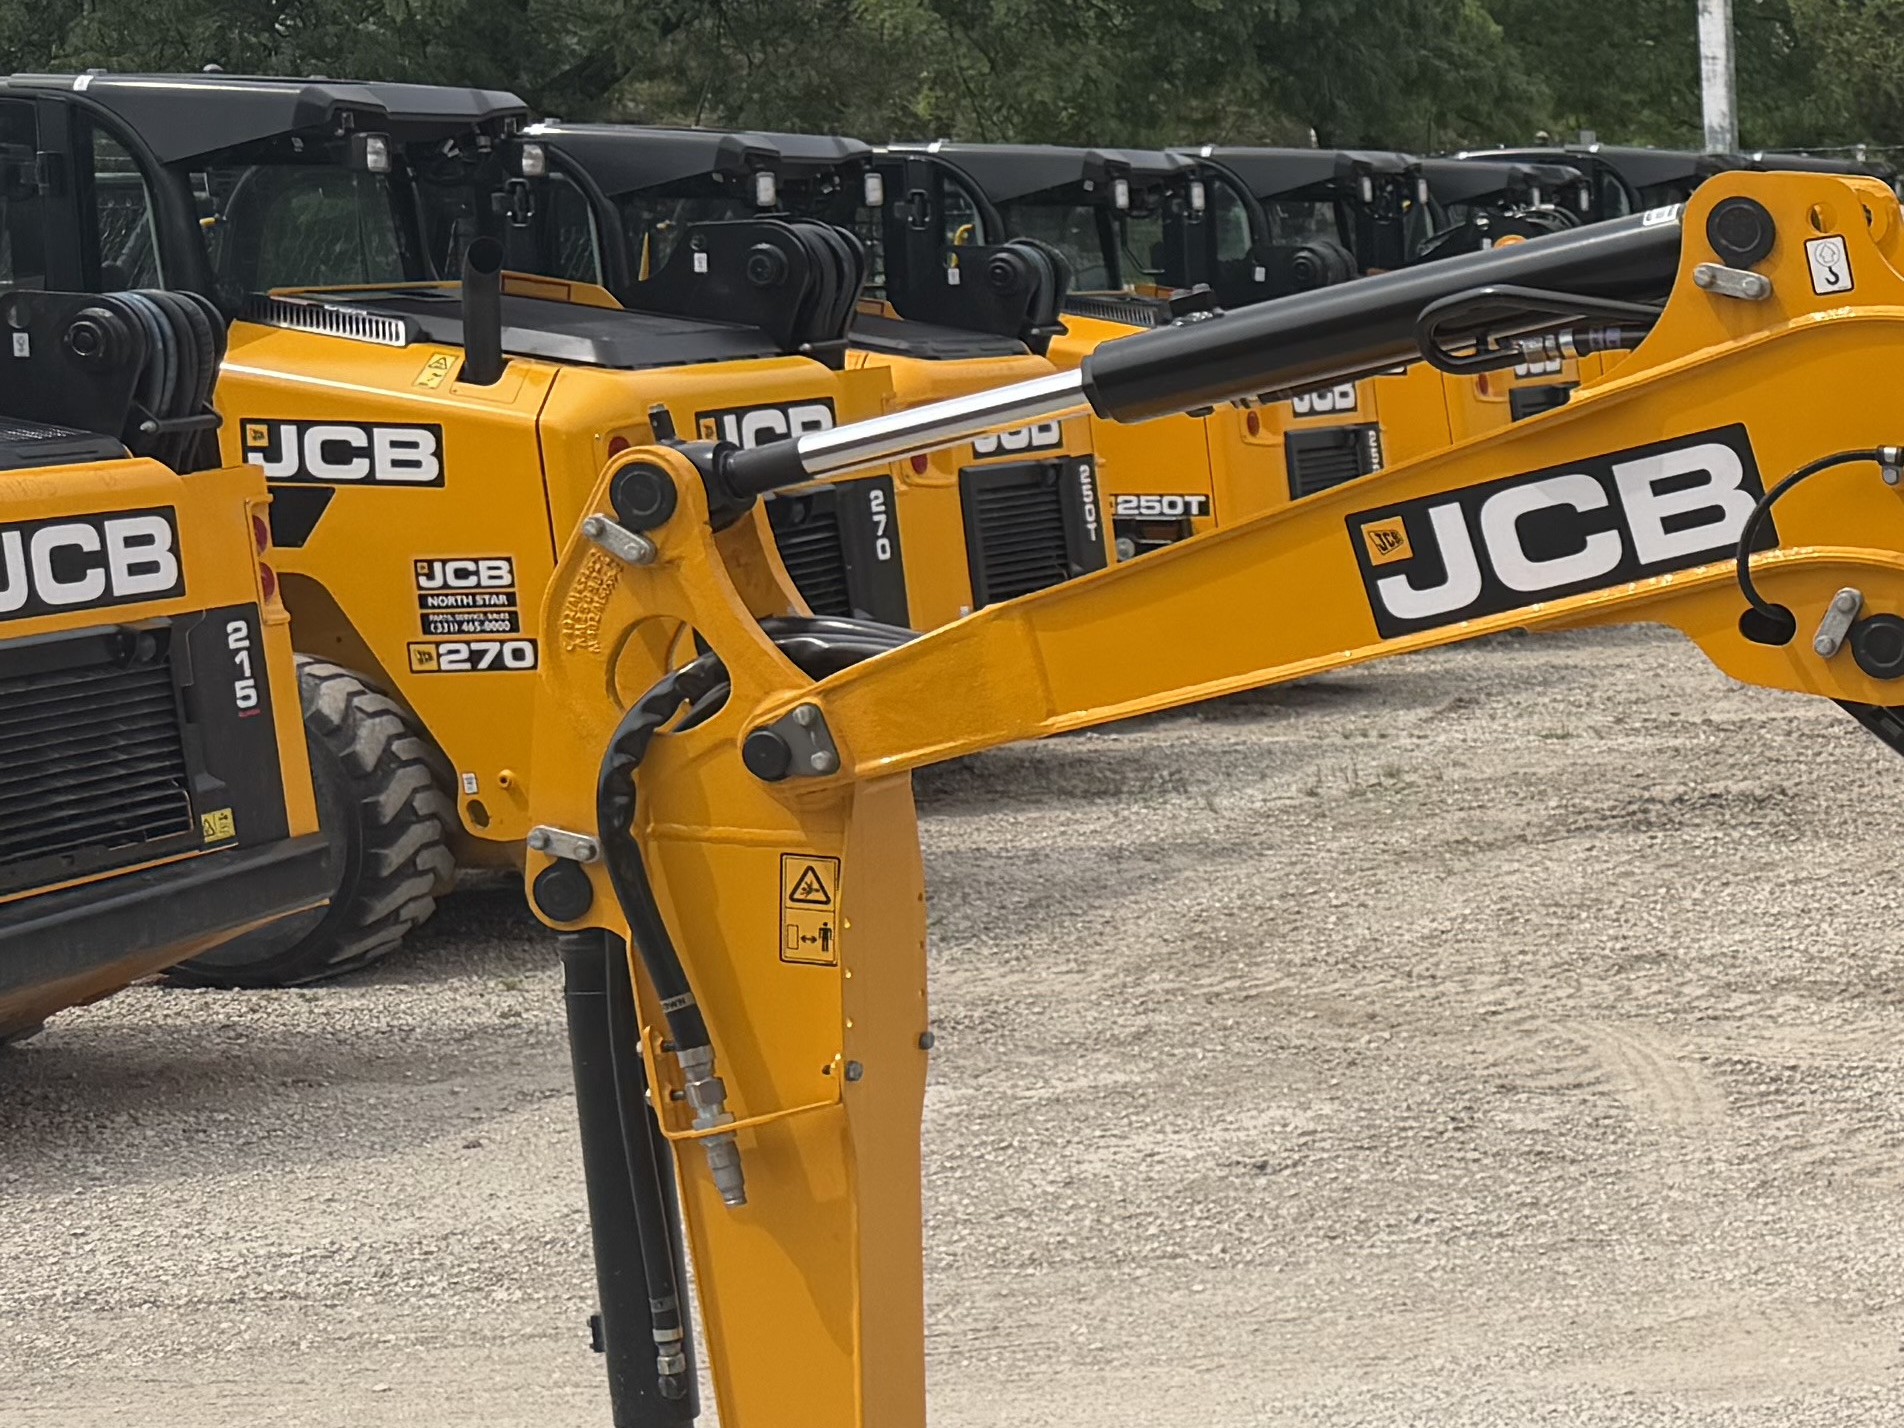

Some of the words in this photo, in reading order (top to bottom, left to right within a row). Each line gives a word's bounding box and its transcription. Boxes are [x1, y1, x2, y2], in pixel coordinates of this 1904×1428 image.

[247, 424, 440, 482] JCB
[869, 489, 891, 561] 270
[1079, 464, 1097, 542] 250T
[1116, 495, 1207, 515] 250T
[1377, 443, 1757, 619] JCB
[418, 560, 513, 589] JCB
[427, 595, 473, 607] NORTH
[475, 594, 509, 606] STAR
[226, 620, 258, 709] 215
[438, 640, 535, 671] 270
